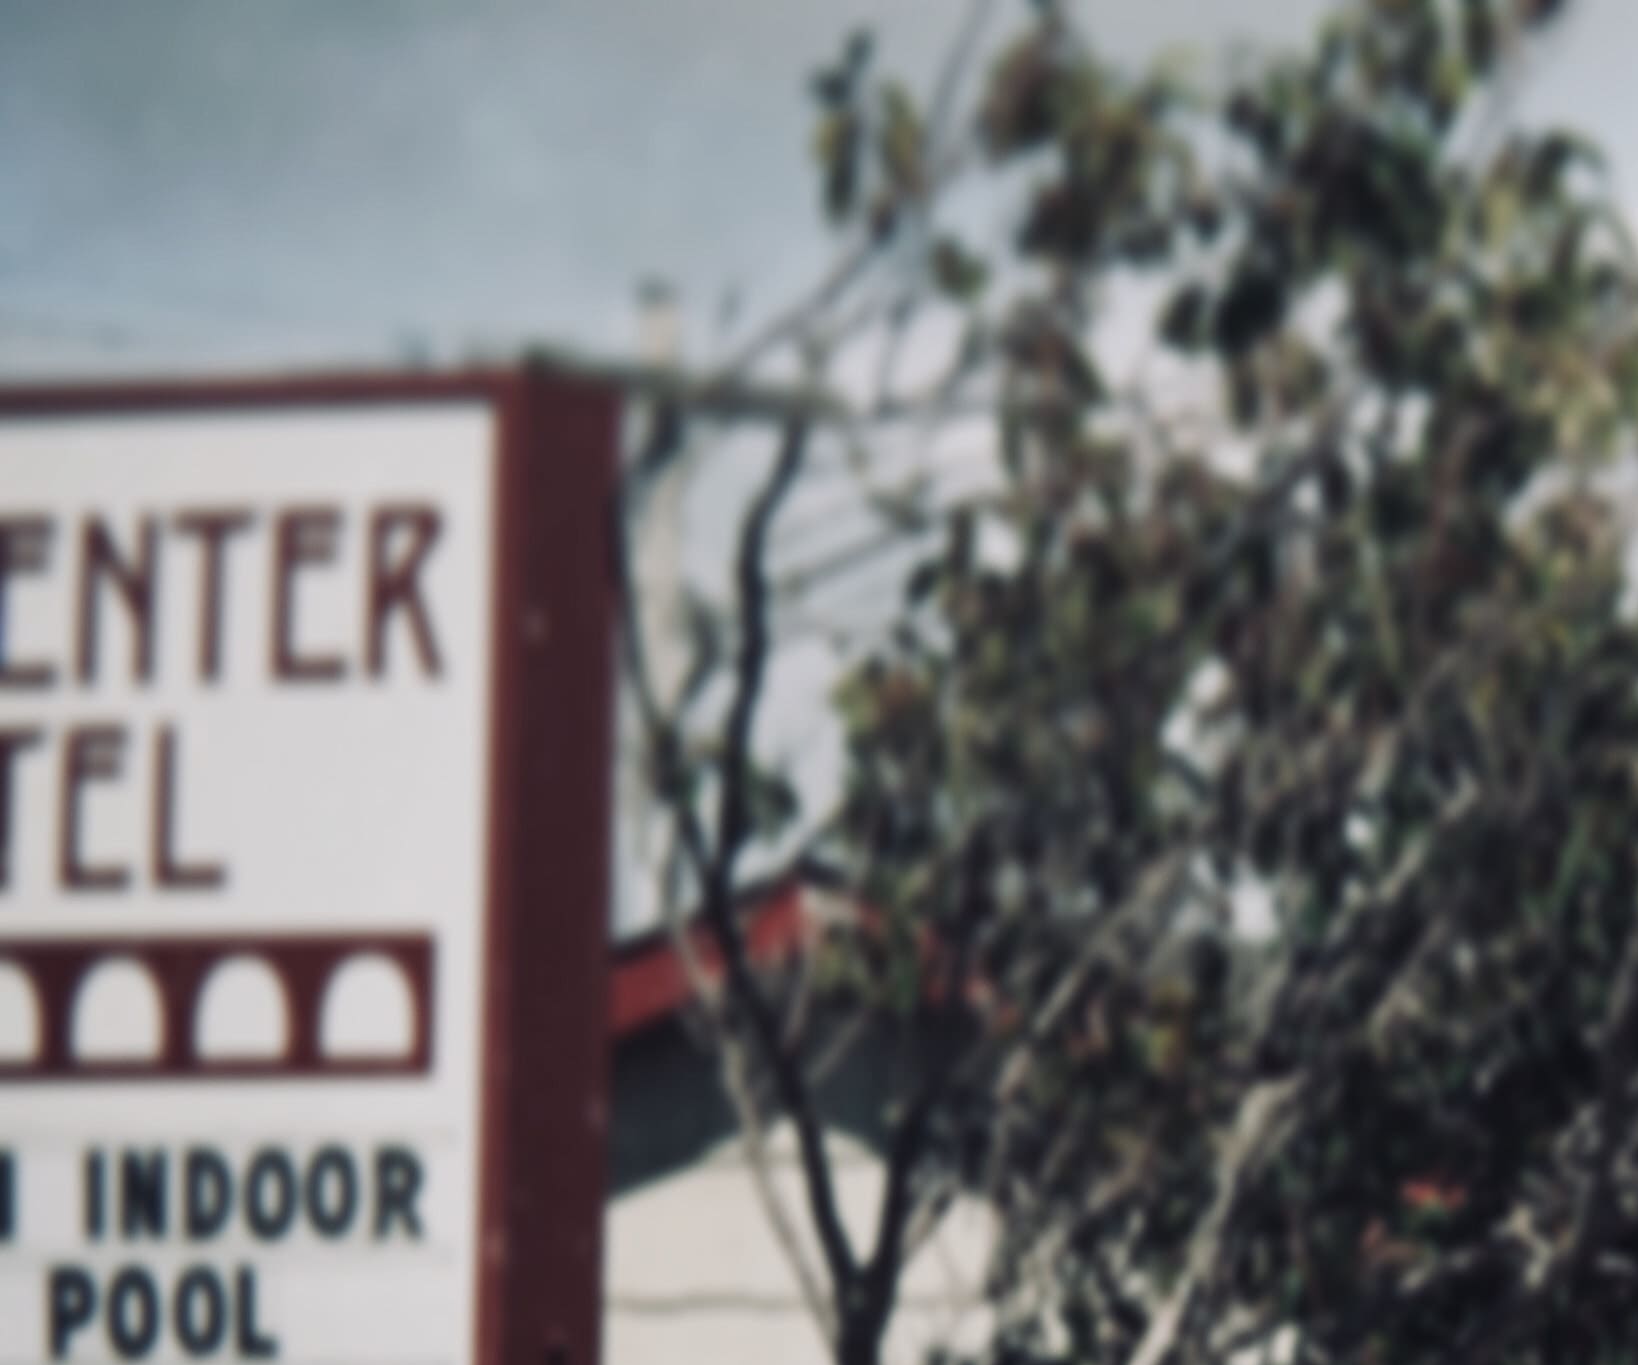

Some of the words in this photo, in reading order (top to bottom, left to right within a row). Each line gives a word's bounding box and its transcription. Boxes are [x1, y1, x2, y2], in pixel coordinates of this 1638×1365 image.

[0, 502, 444, 688] ENTER
[83, 1143, 426, 1244] INDOOR
[47, 1262, 279, 1362] POOL
